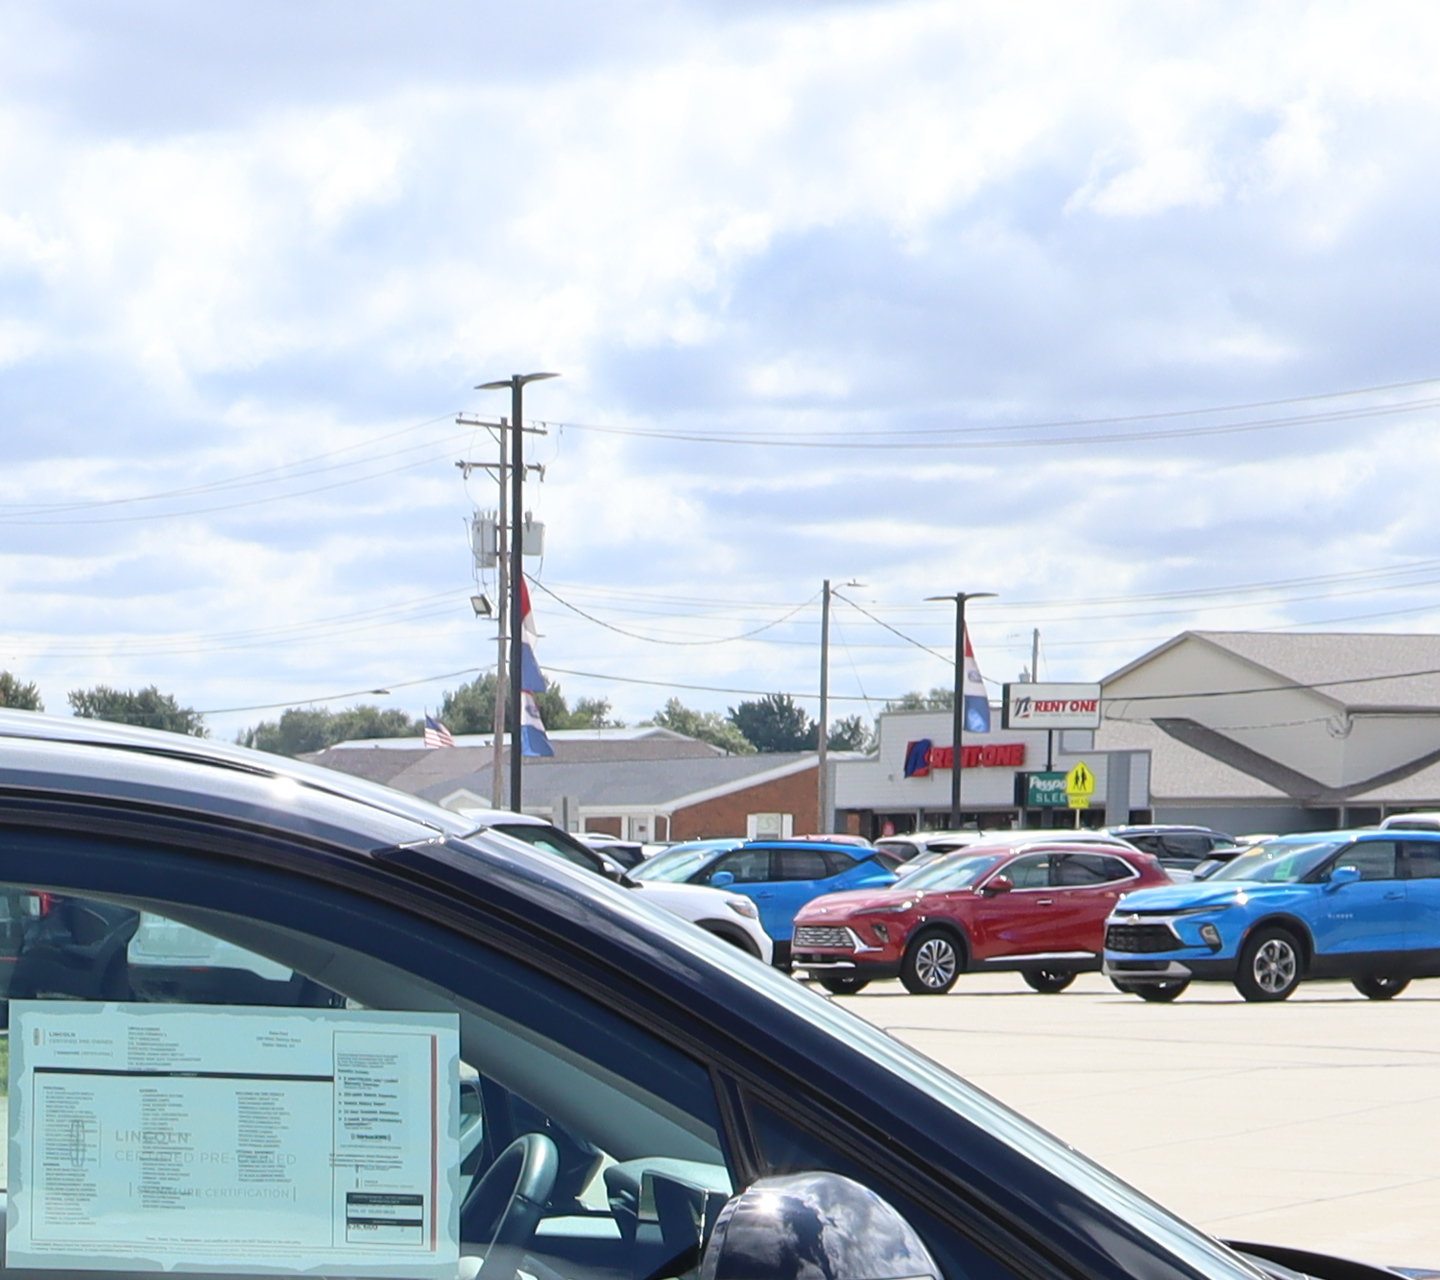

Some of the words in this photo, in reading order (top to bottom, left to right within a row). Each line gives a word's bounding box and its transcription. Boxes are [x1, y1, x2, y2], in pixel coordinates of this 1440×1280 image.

[1034, 700, 1069, 712] RENT
[1070, 700, 1098, 712] ONE
[982, 744, 1025, 767] ONE
[1029, 776, 1067, 792] Passpo
[1036, 792, 1067, 804] SLEE
[115, 1130, 189, 1144] LINCOLN
[205, 1186, 290, 1199] CERTIFICATION
